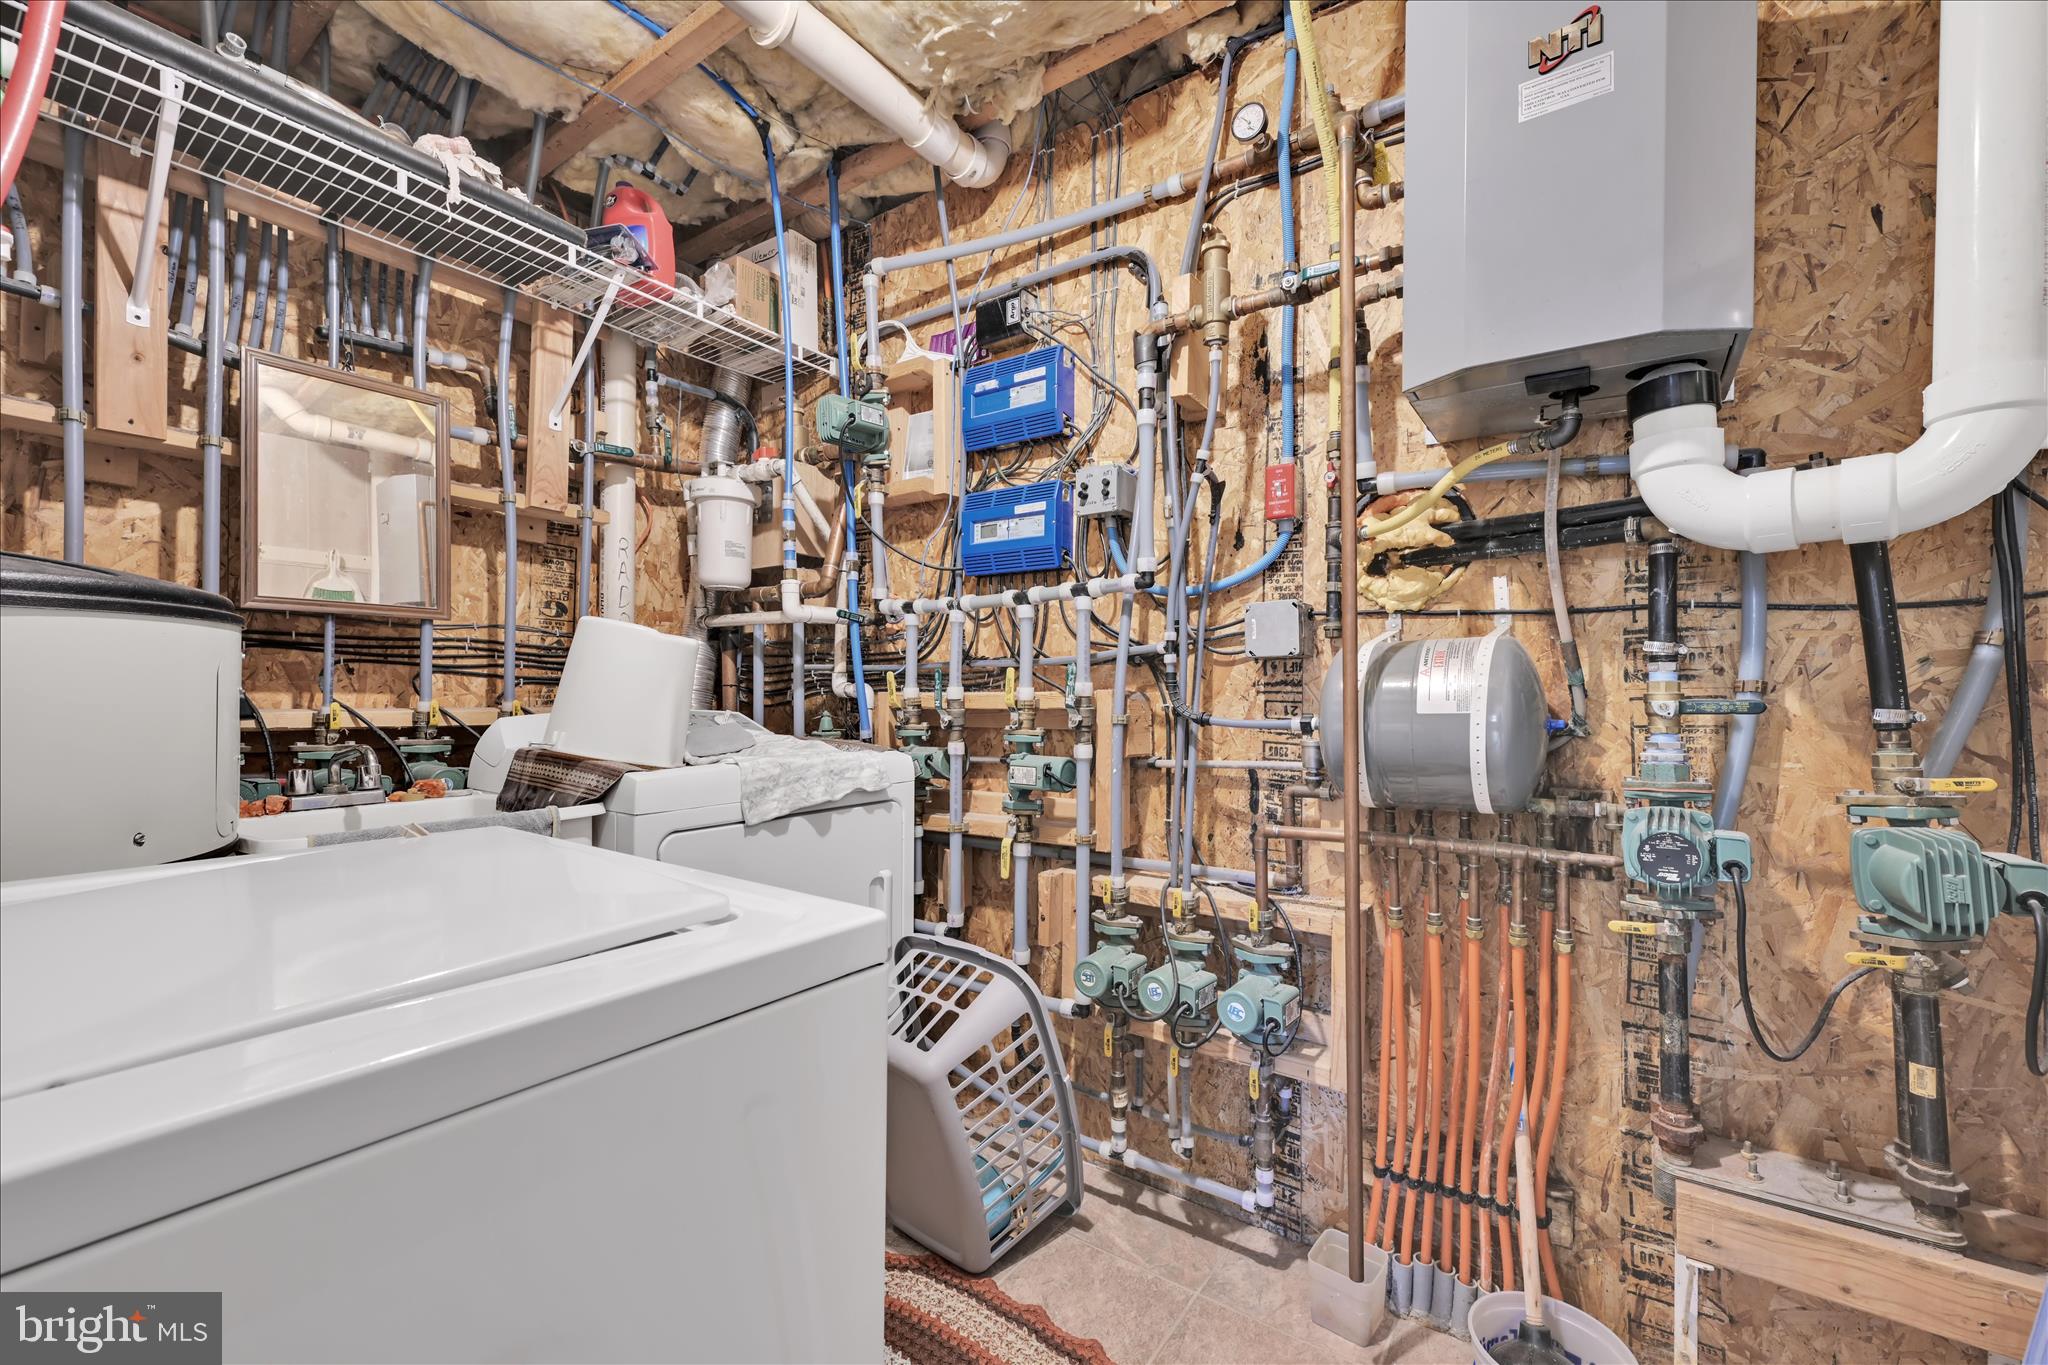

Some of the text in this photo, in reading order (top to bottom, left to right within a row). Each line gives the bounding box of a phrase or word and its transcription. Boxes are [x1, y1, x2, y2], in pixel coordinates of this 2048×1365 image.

[1528, 13, 1604, 69] NTI
[1009, 302, 1017, 320] Argo
[1639, 1250, 1664, 1266] OCT
